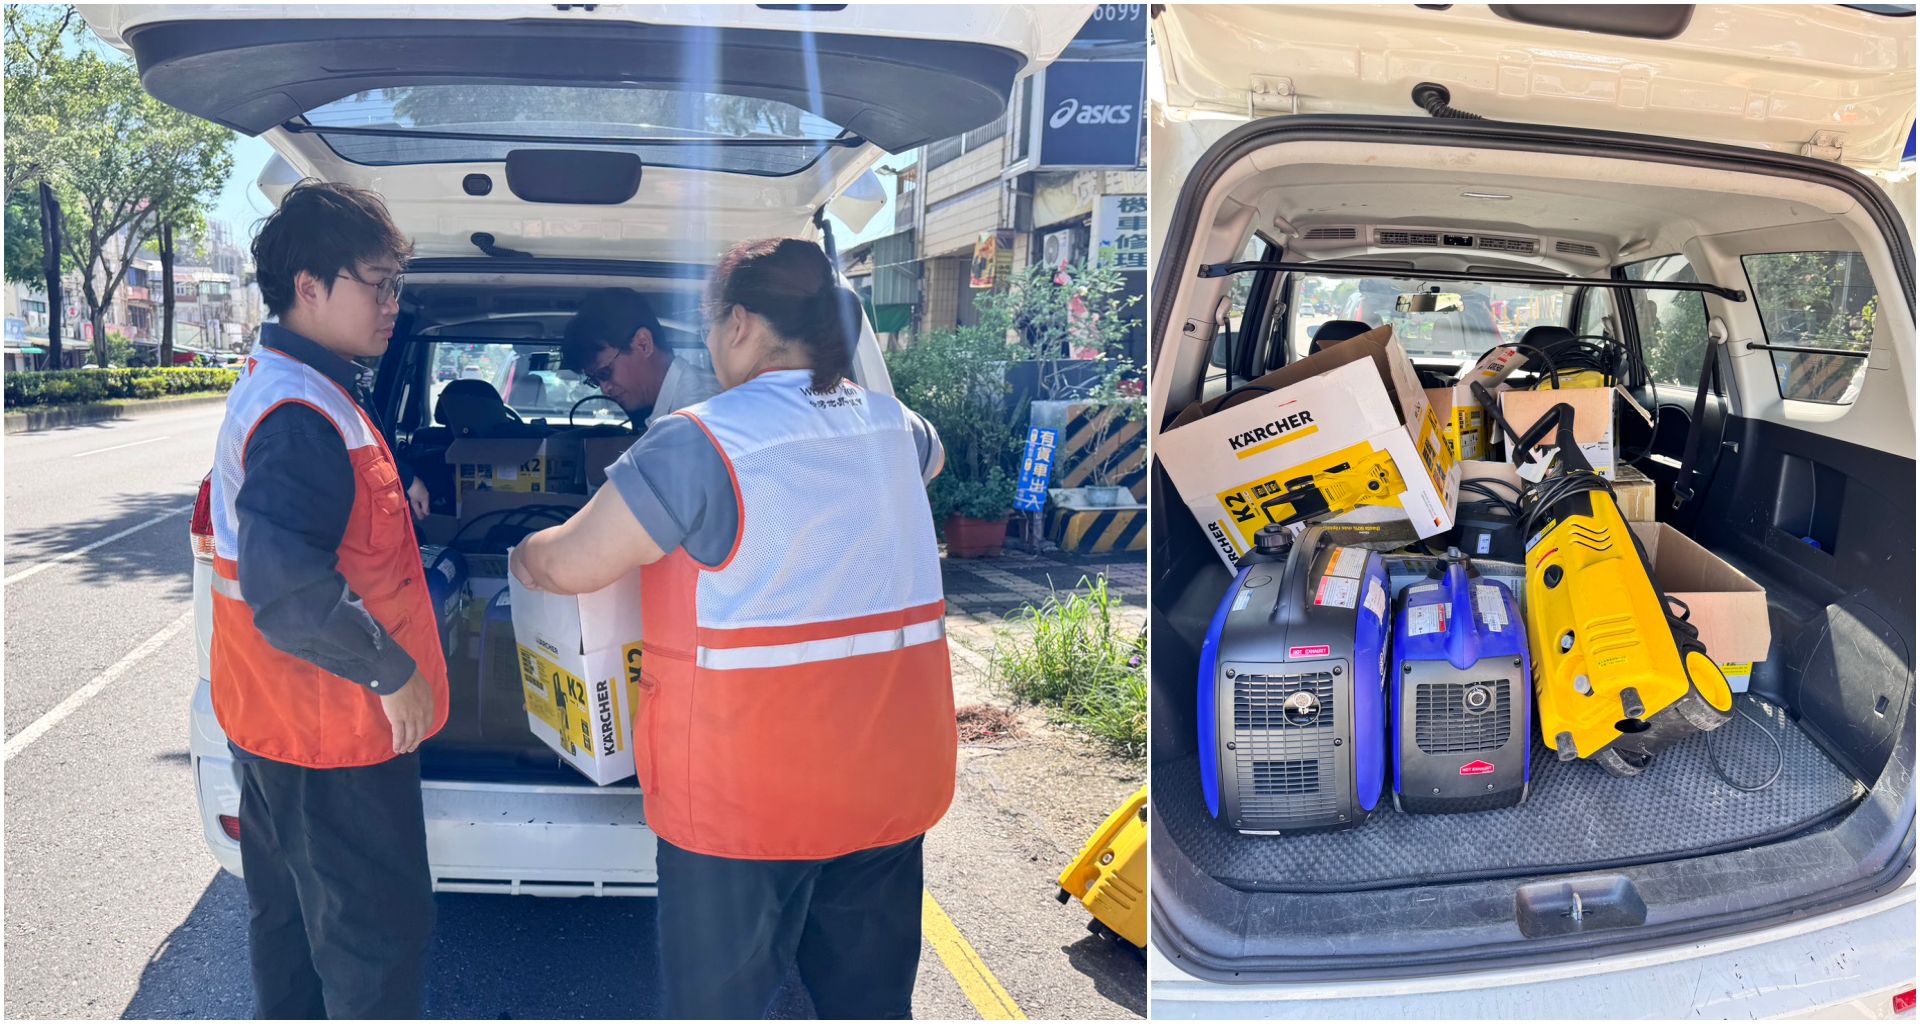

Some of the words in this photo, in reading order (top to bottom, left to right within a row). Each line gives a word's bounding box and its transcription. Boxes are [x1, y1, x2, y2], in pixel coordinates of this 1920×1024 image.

[1076, 104, 1132, 124] asics
[1228, 410, 1314, 450] KÄRCHER
[1225, 492, 1255, 522] K2
[1208, 521, 1240, 567] RCHER
[567, 675, 585, 705] K2
[596, 679, 615, 756] KÄRCHER
